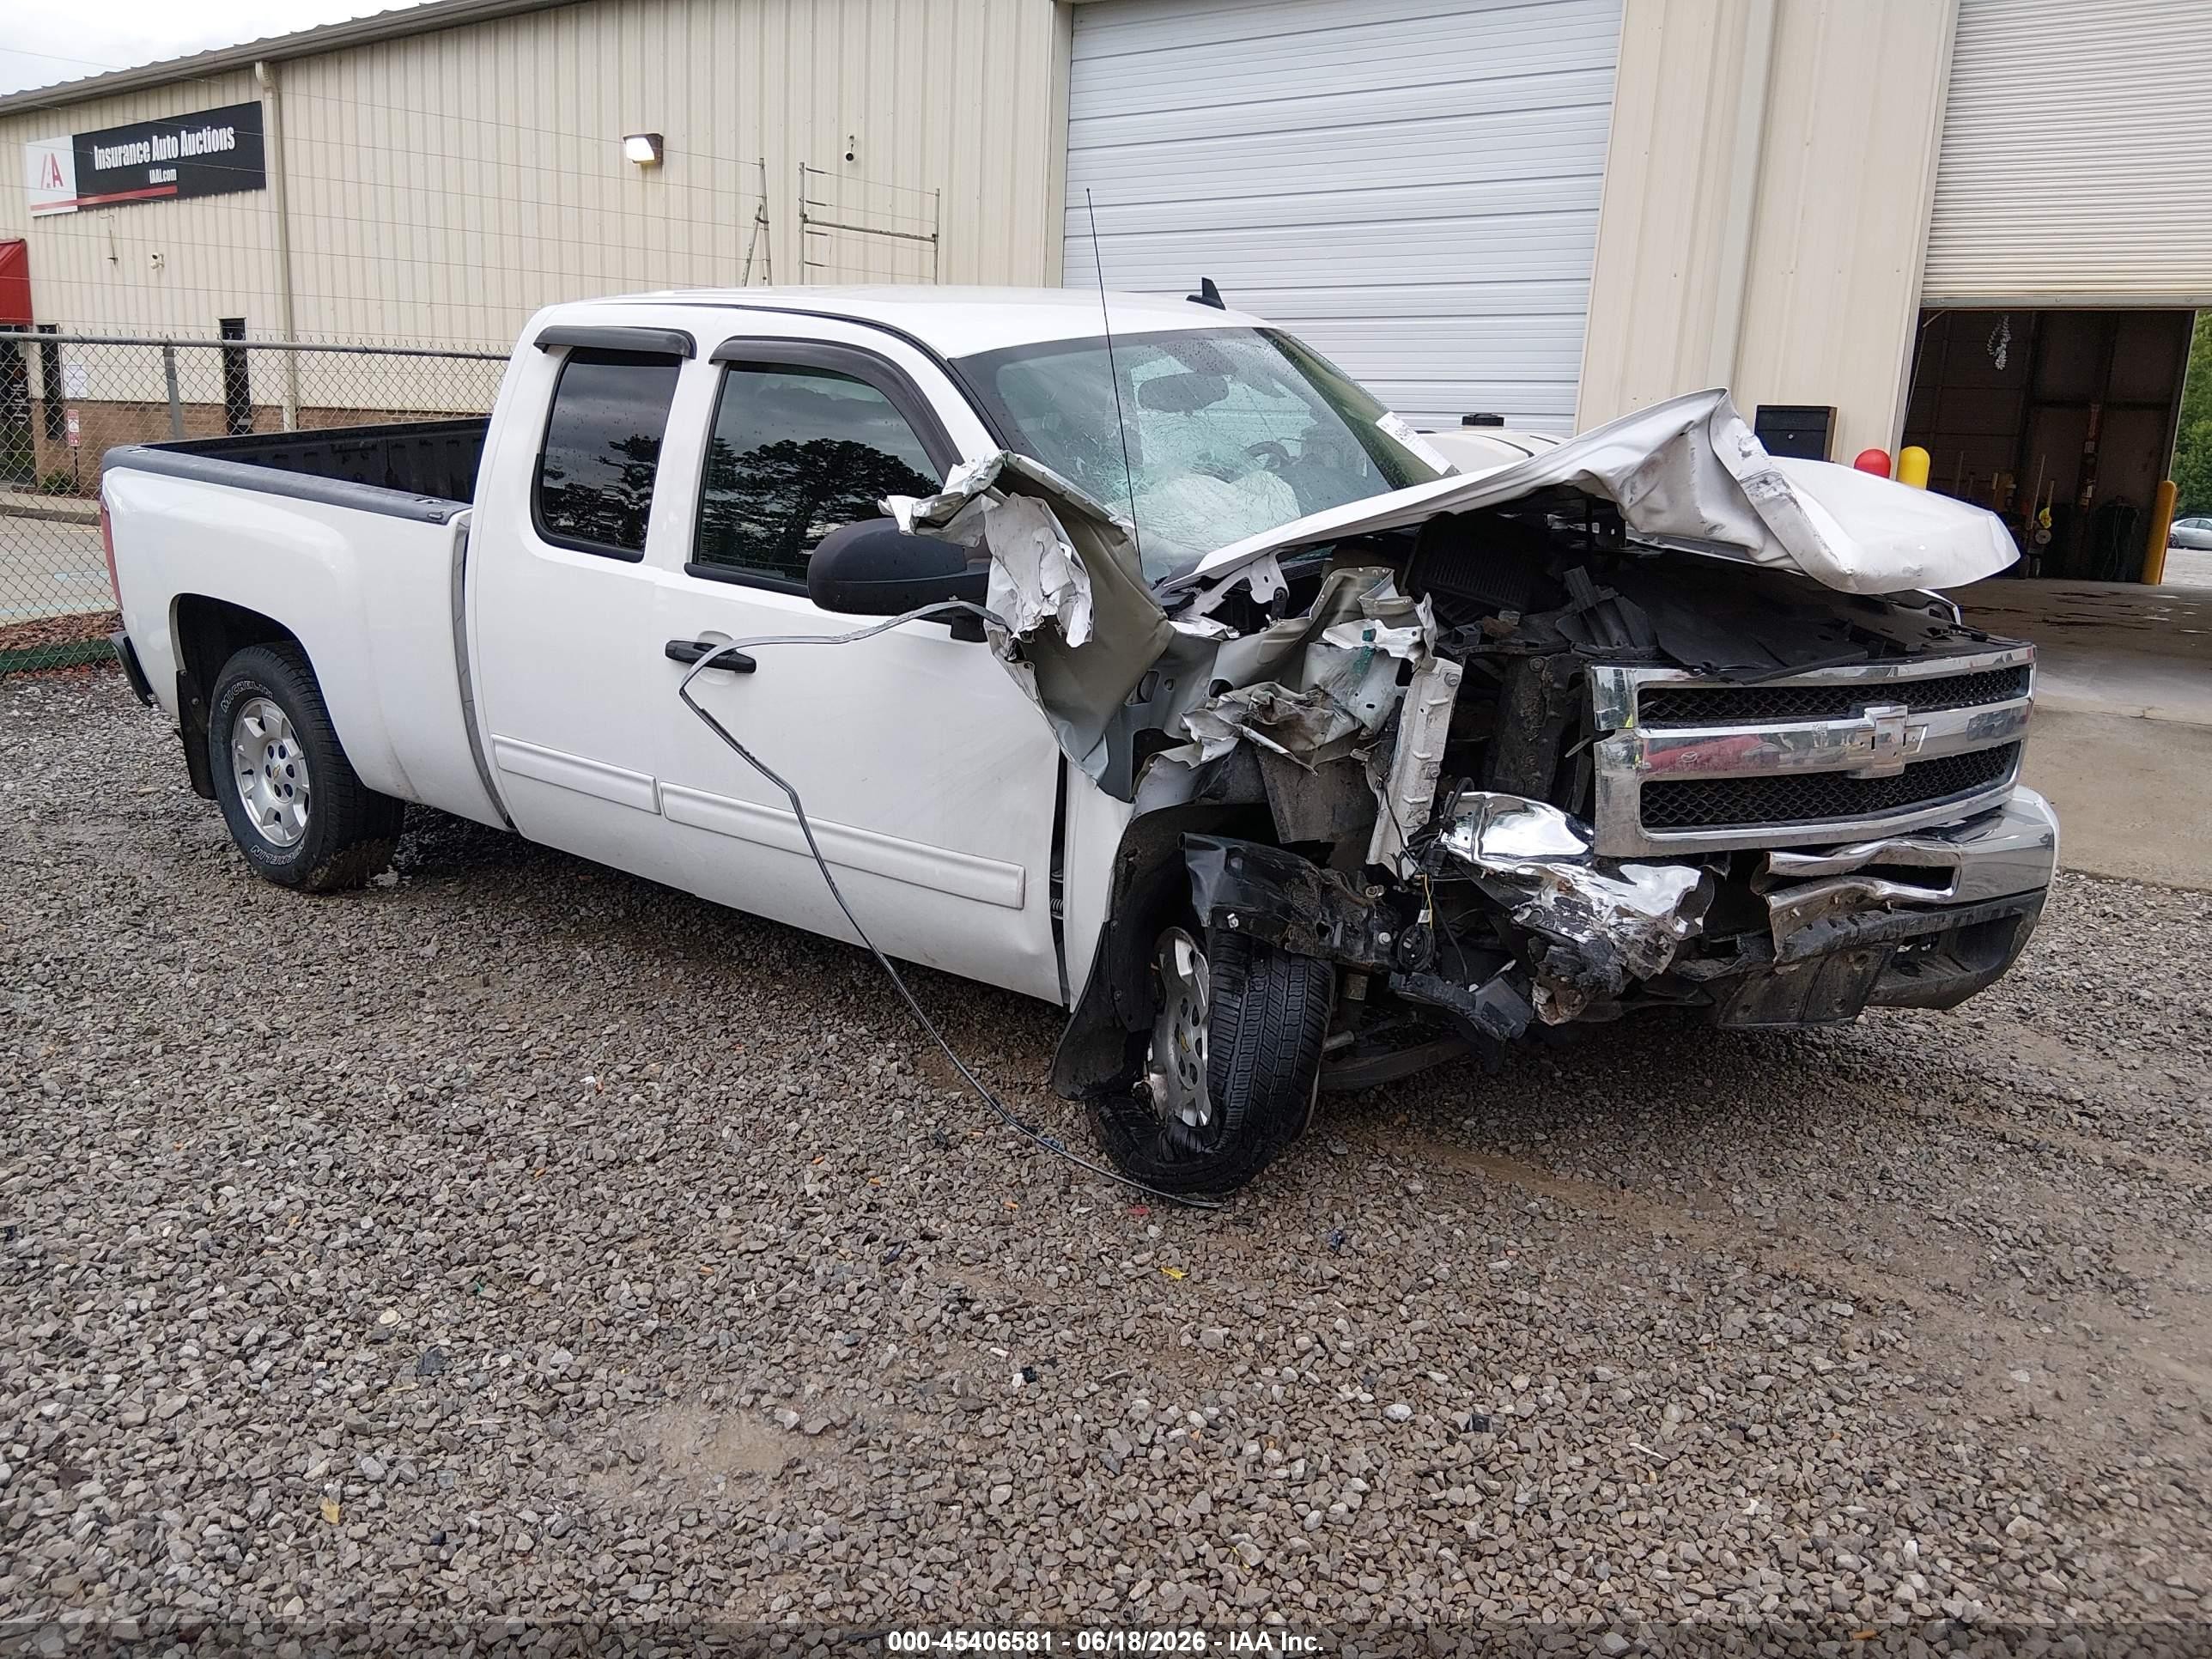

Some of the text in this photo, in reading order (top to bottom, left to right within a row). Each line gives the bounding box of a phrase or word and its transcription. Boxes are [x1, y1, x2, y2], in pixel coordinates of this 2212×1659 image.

[94, 125, 235, 170] Insurance Auto Auctions
[220, 679, 273, 714] MICHELIN
